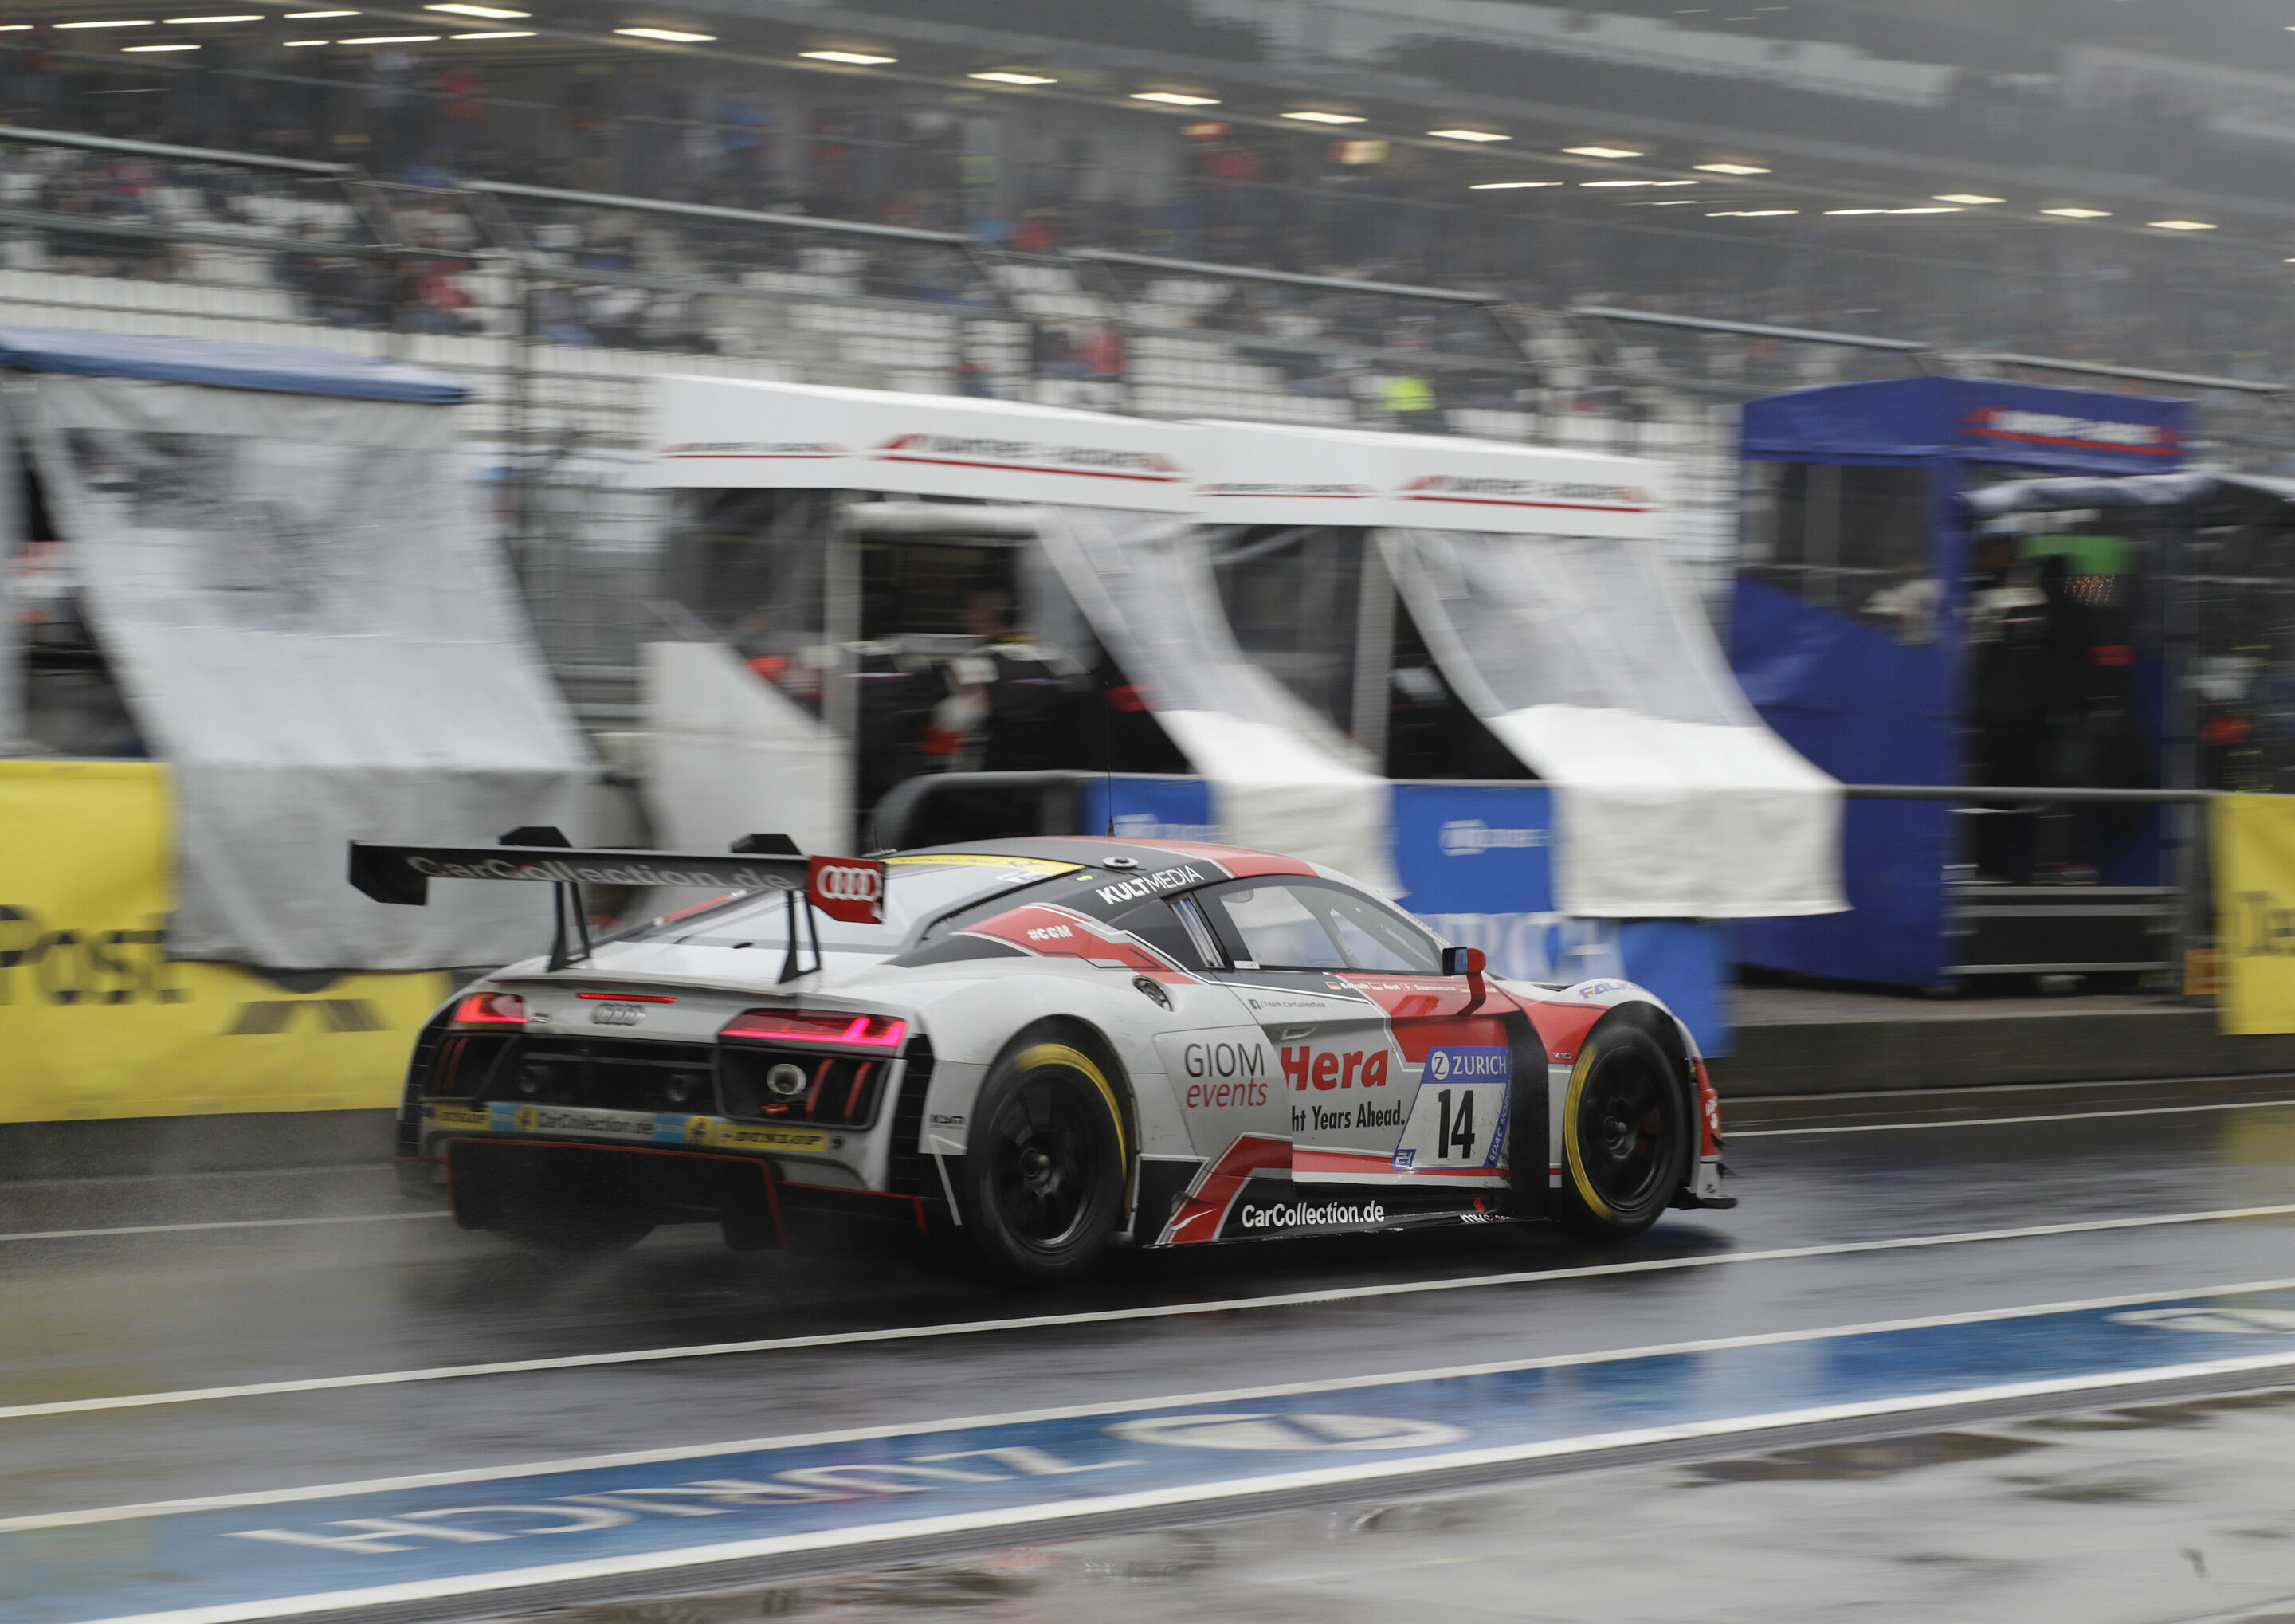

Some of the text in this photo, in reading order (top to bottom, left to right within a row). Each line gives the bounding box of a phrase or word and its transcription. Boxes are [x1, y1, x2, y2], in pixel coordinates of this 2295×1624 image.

[1096, 865, 1205, 904] KULTMEDIA
[1184, 1042, 1265, 1077] GIOM
[1281, 1046, 1388, 1091] Hera
[1453, 1056, 1508, 1075] ZURICH
[1186, 1077, 1269, 1108] events
[1312, 1104, 1352, 1131] Years
[1356, 1100, 1406, 1128] Ahead.
[1438, 1089, 1476, 1159] 14
[733, 1131, 821, 1146] DUNLOP
[1242, 1200, 1385, 1228] CarCollection.de
